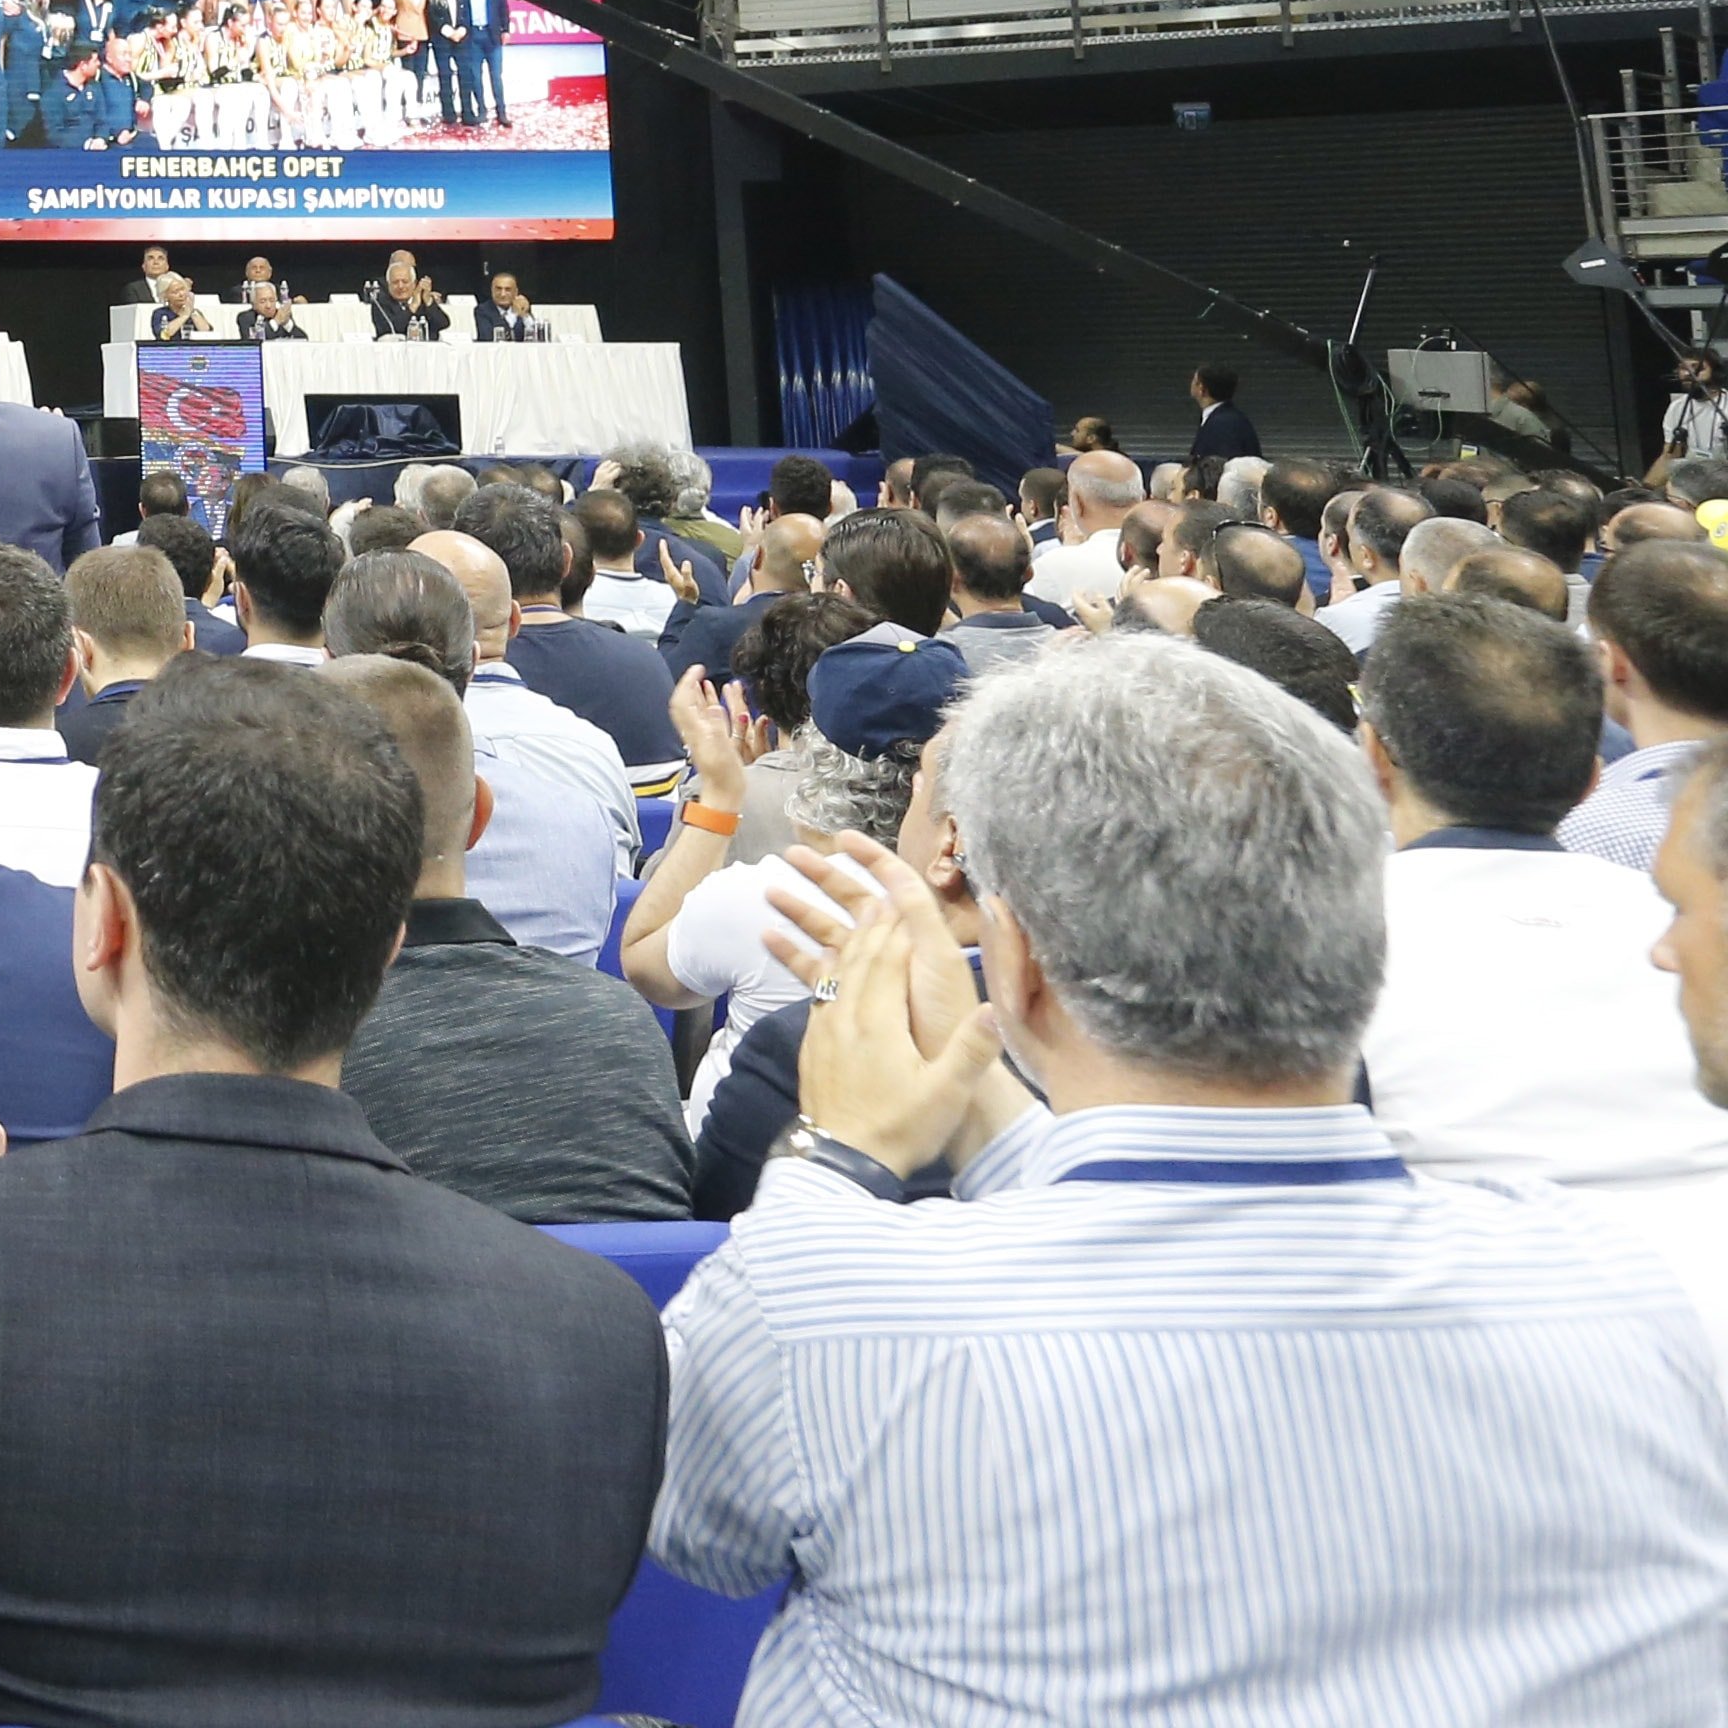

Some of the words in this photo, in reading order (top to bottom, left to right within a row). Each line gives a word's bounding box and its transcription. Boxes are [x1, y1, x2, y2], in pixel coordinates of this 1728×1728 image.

[120, 155, 277, 181] FENERBAHÇE
[283, 155, 345, 178] OPET
[27, 183, 201, 213] ŞAMPİYONLAR
[206, 187, 296, 210] KUPASI
[302, 184, 445, 213] ŞAMPİYONU
